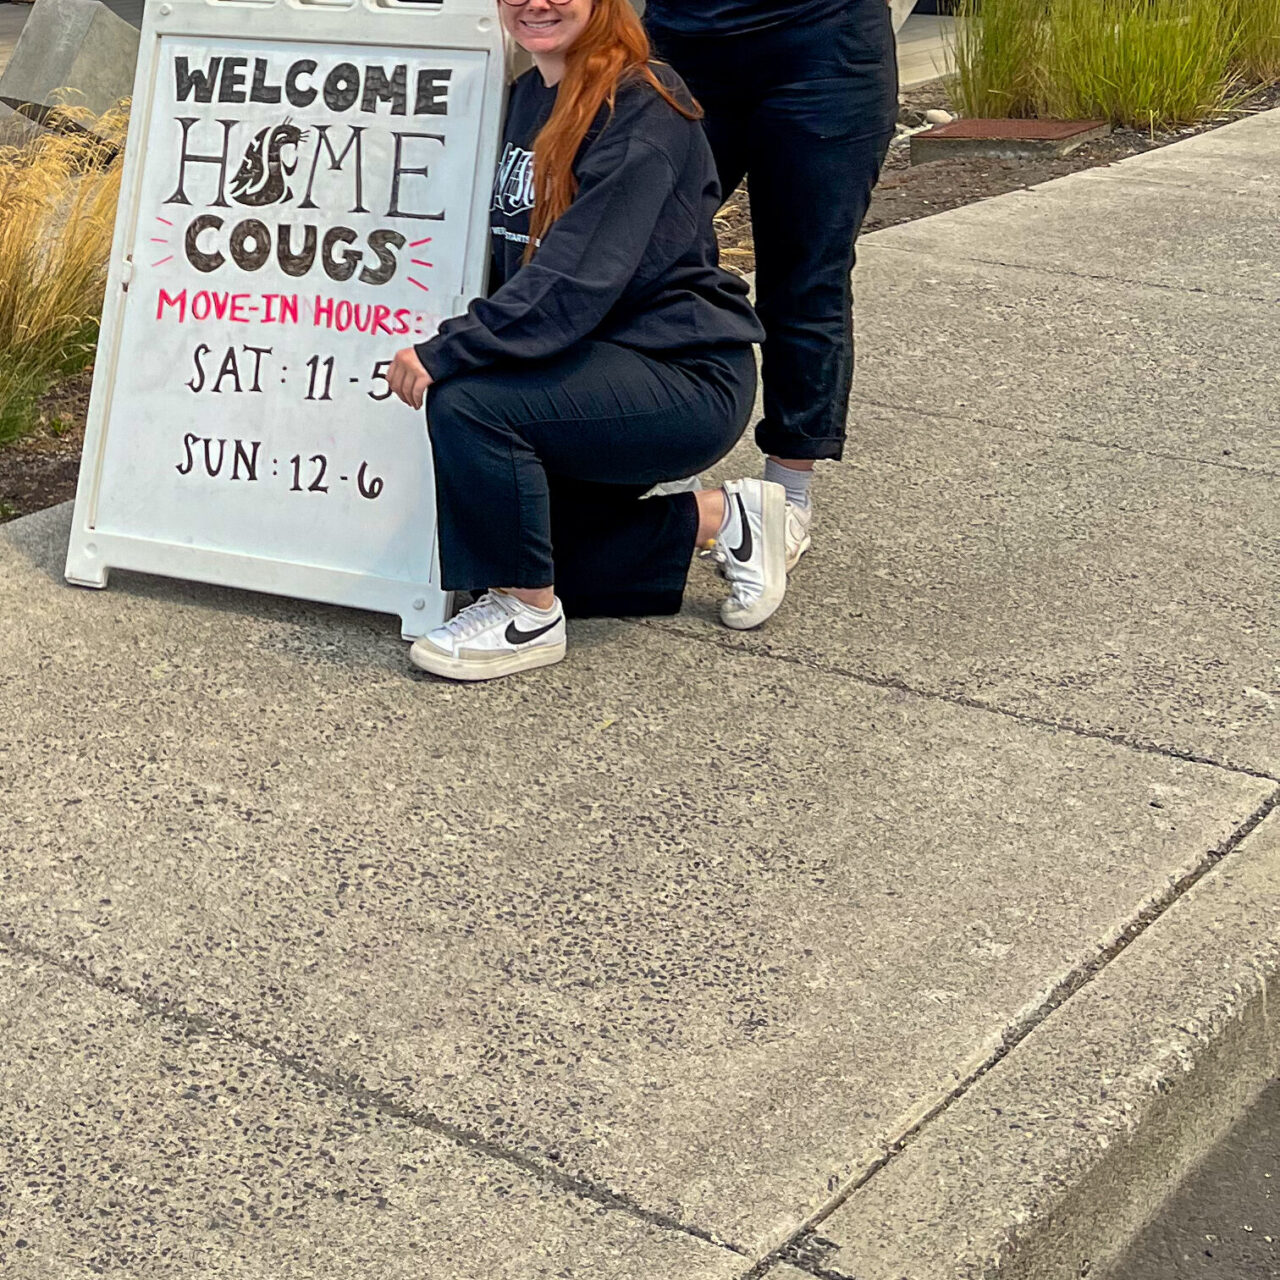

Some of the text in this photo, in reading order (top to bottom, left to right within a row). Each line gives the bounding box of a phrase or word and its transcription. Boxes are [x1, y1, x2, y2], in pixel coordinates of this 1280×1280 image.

[174, 56, 453, 116] WELCOME
[184, 214, 407, 286] COUGS
[156, 288, 423, 336] MOVE-IN HOURS:
